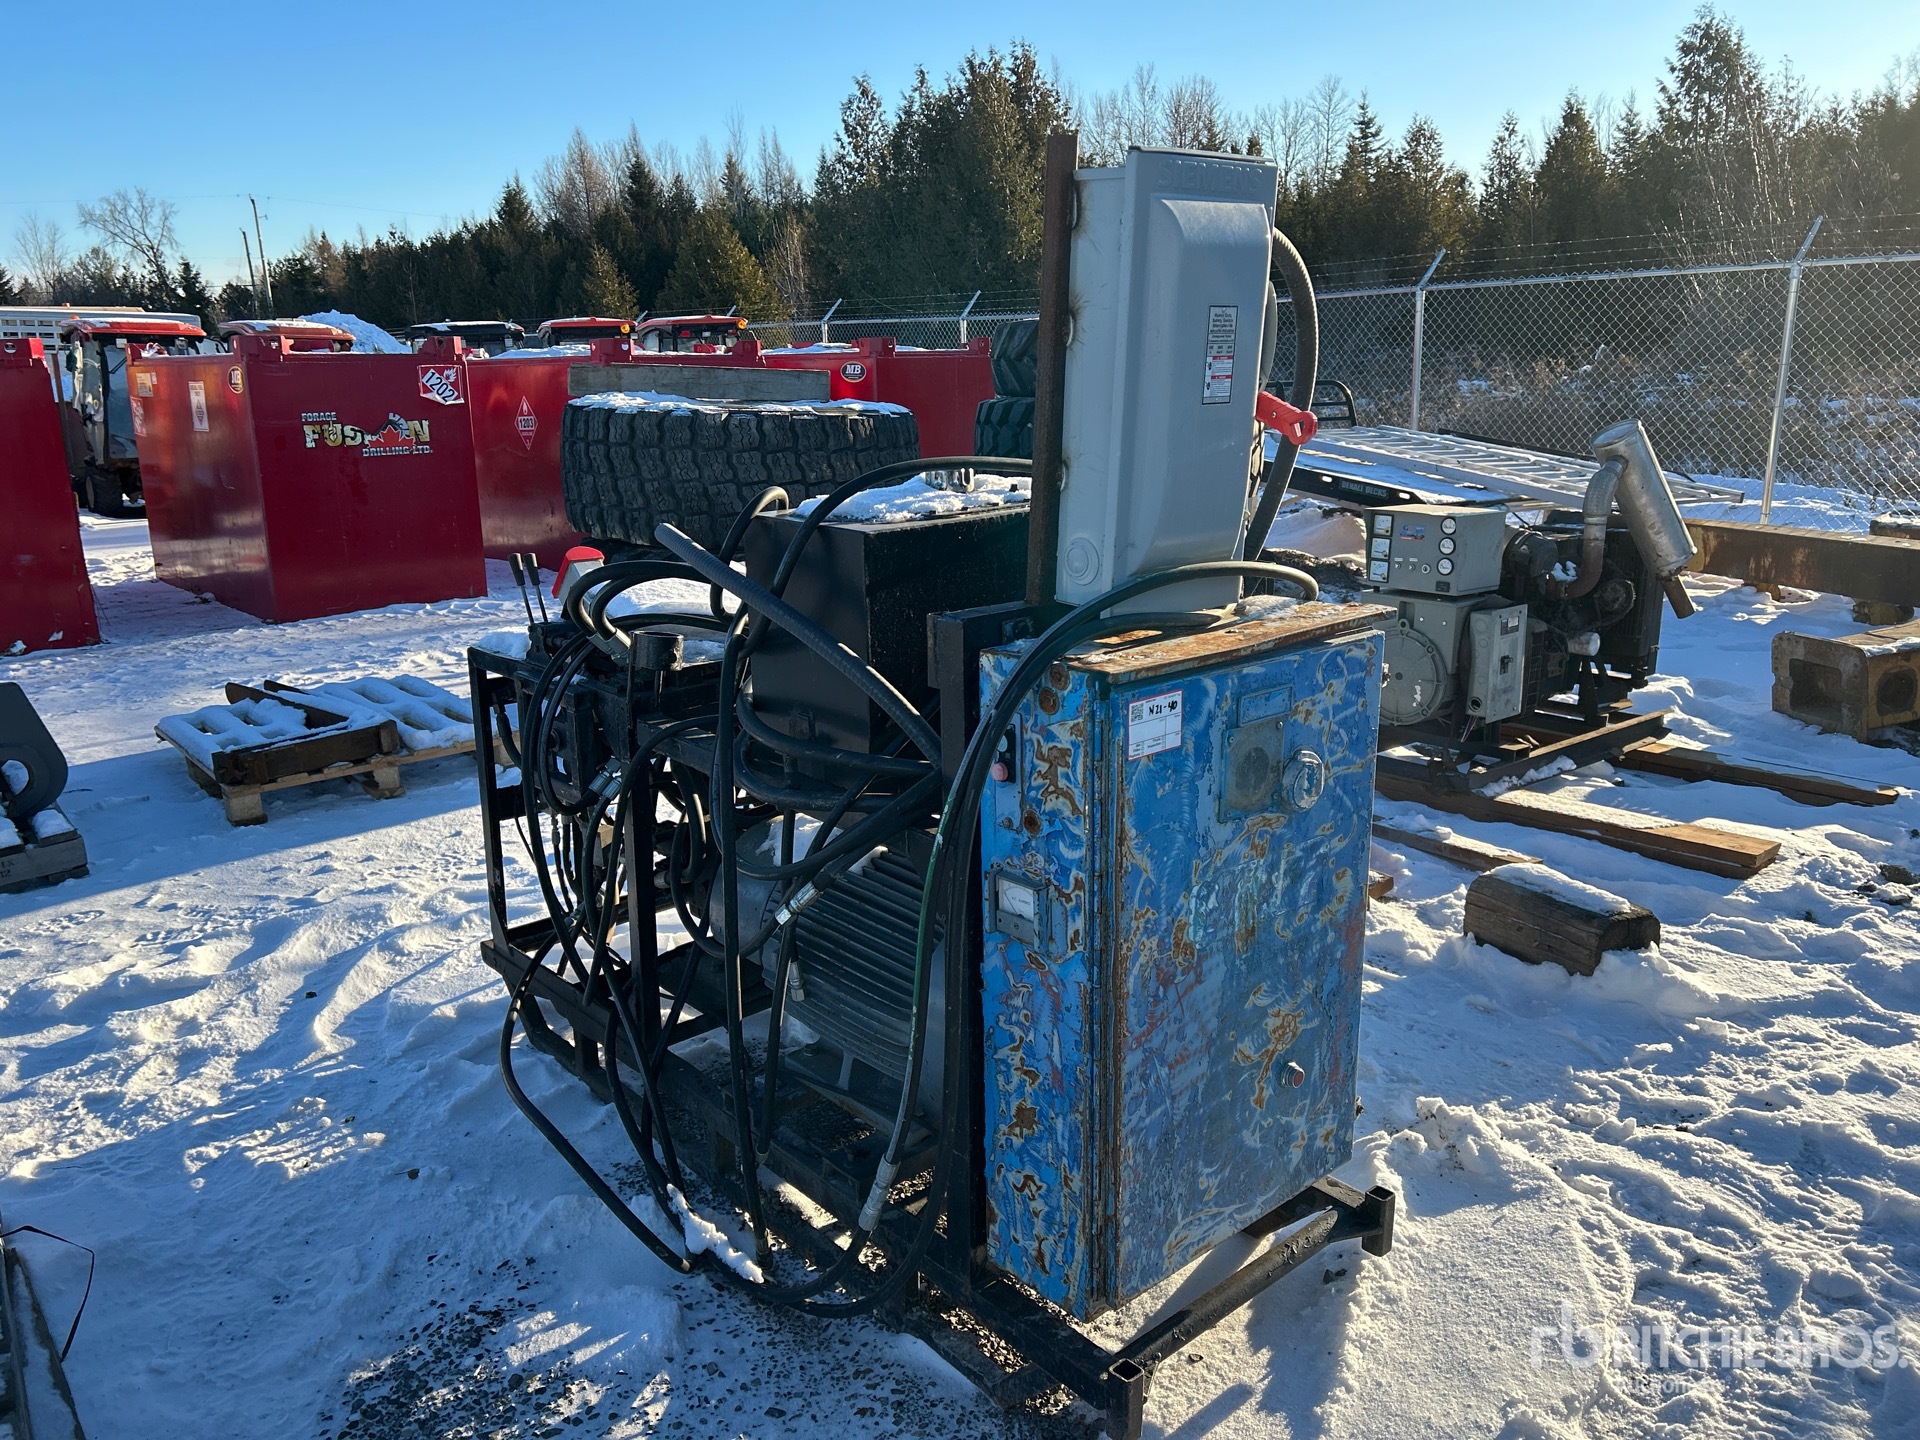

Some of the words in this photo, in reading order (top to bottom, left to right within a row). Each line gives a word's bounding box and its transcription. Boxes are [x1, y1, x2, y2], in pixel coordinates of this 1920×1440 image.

[1158, 158, 1263, 192] SIEMENS
[845, 364, 862, 374] MB
[425, 371, 456, 402] 1202
[301, 412, 337, 422] FORAGE
[519, 418, 534, 428] 1203
[362, 446, 410, 457] DRILLING
[412, 445, 433, 455] LTD.
[1365, 486, 1387, 497] DECKS
